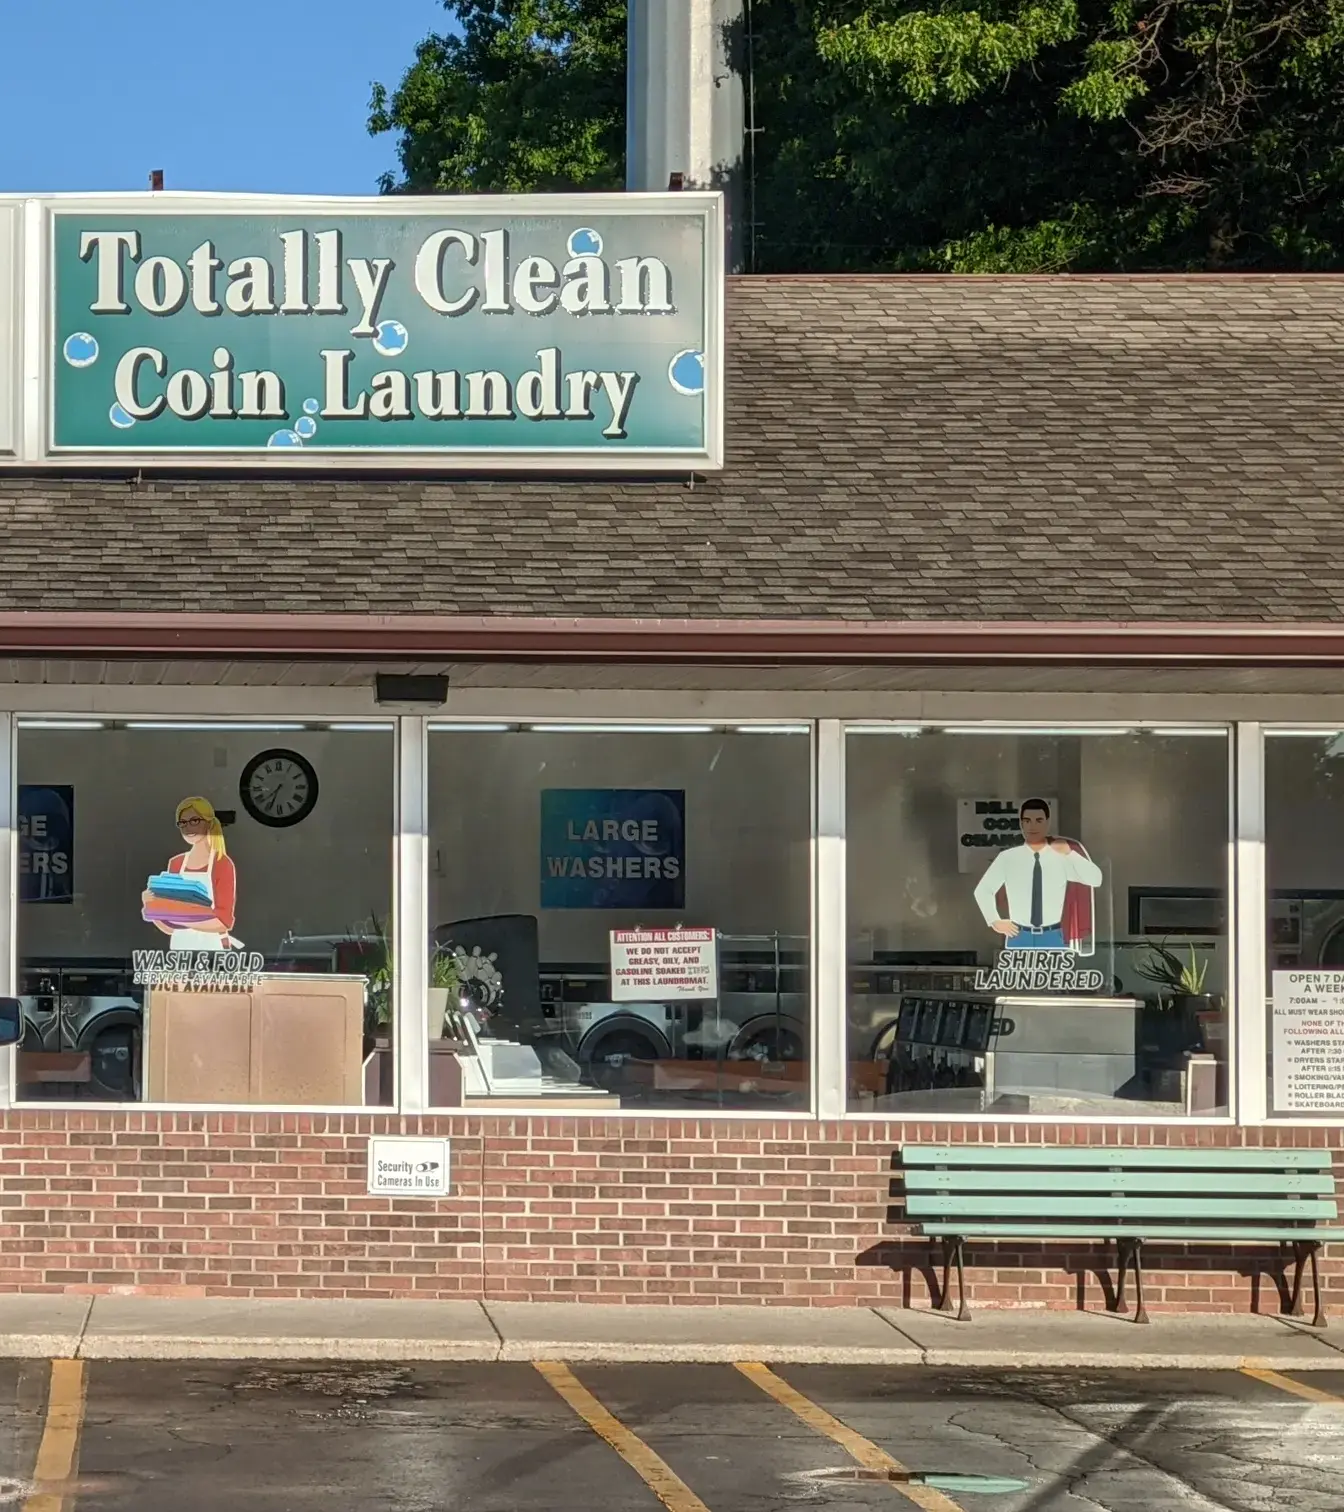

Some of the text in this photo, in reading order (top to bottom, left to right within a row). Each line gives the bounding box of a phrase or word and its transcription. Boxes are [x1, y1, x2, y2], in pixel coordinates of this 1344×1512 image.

[78, 228, 678, 338] Totally Clean
[113, 345, 639, 439] Coin Laundry
[567, 819, 658, 841] LARGE
[546, 856, 680, 879] WASHERS
[654, 931, 666, 941] ALL
[626, 946, 701, 955] WE DO NOT ACCEPT
[132, 950, 265, 973] WASH & FOLD
[683, 956, 700, 964] AND
[997, 950, 1076, 970] SHIRTS
[133, 971, 265, 986] SERVICE AVAILABLE
[615, 968, 653, 976] GASOLINE
[655, 967, 686, 975] SOAKED
[1289, 974, 1321, 983] OPEN
[1324, 974, 1330, 983] 7
[620, 978, 630, 986] AT
[974, 969, 1104, 990] LAUNDERED
[1304, 984, 1312, 993] A
[377, 1160, 413, 1175] Security
[377, 1174, 440, 1187] Cameras In Use
